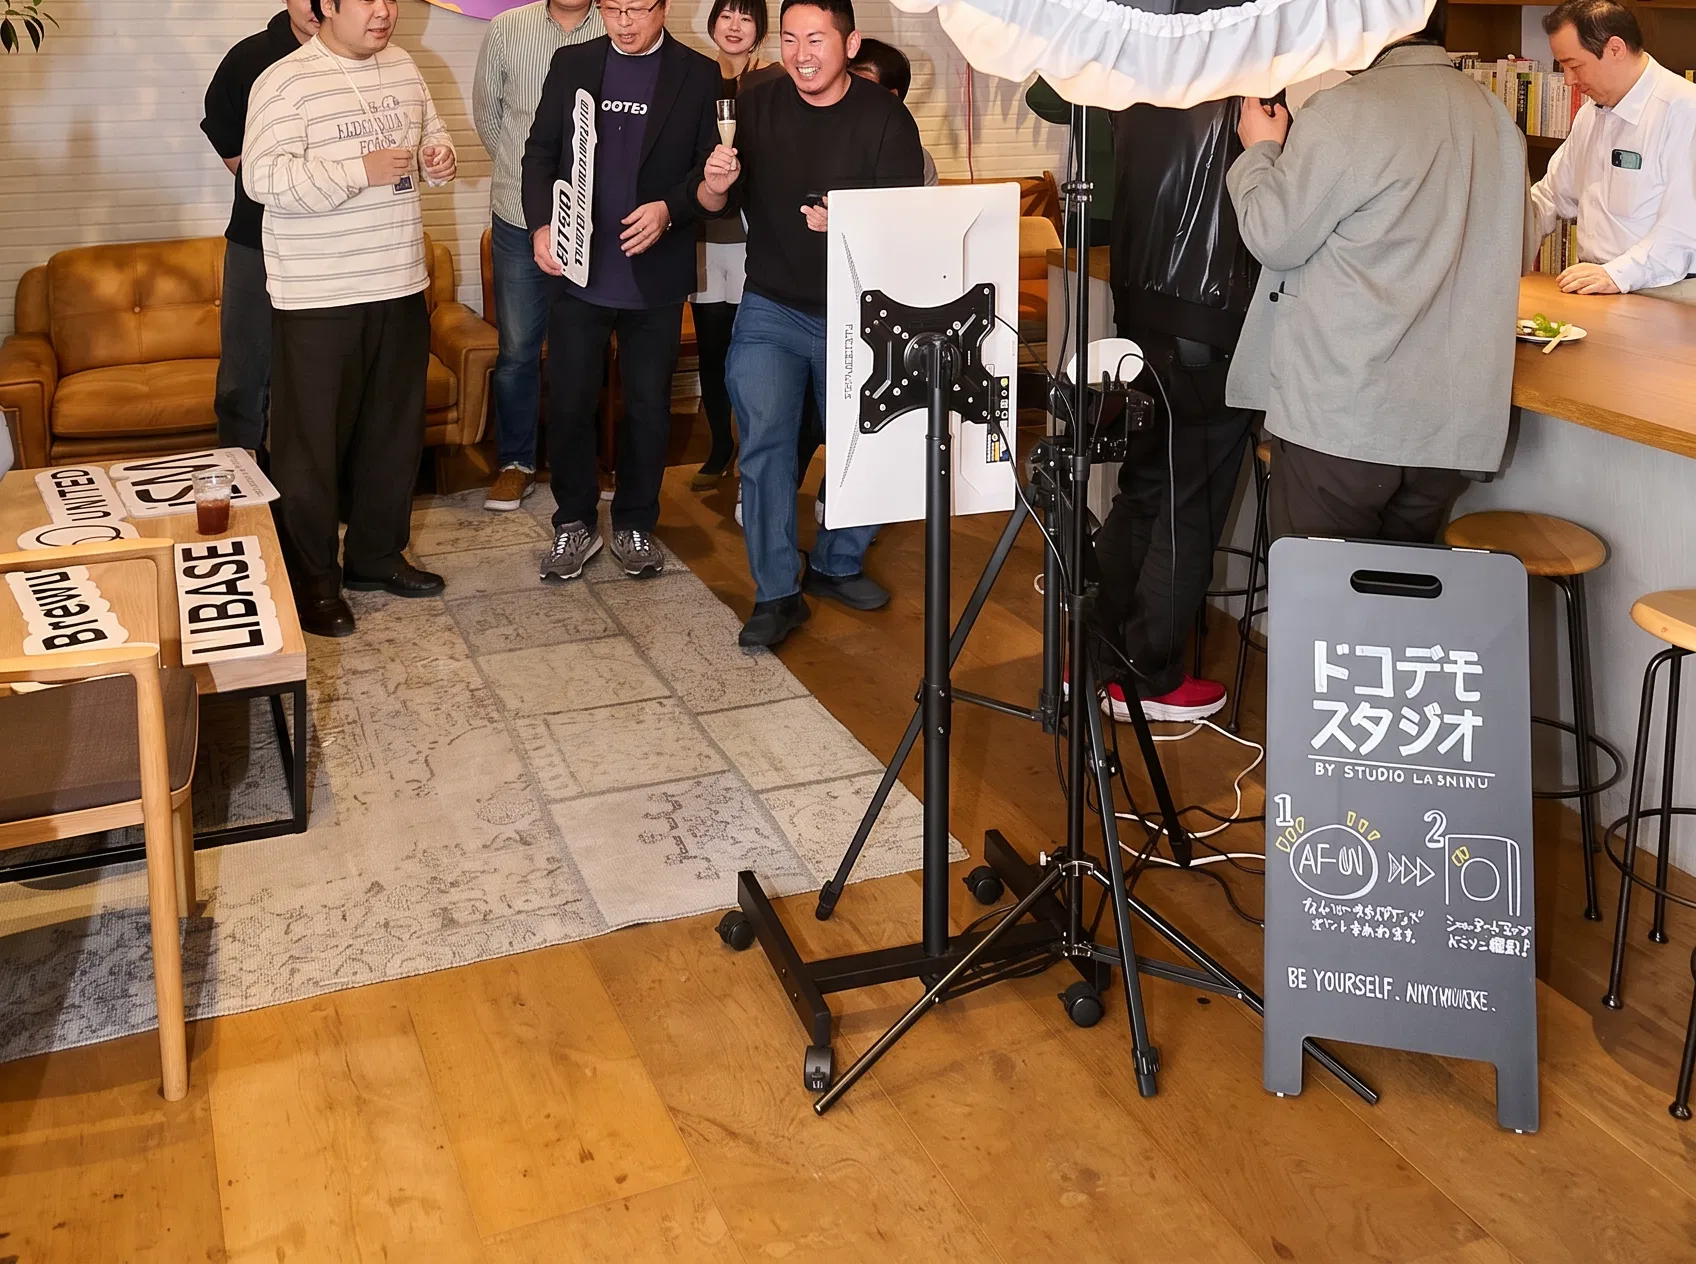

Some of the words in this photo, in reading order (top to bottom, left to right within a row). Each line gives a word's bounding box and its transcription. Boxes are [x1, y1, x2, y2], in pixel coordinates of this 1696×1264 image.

[50, 469, 111, 521] UNITED
[181, 540, 264, 655] LIBASE
[1314, 640, 1483, 702] ドコデモ
[1310, 699, 1484, 762] スタジオ
[1315, 762, 1335, 776] BY
[1344, 766, 1404, 783] STUDIO
[1274, 793, 1295, 827] 1
[1423, 810, 1447, 849] 2
[1288, 966, 1307, 989] BE
[1312, 968, 1401, 1001] YOURSELF.
